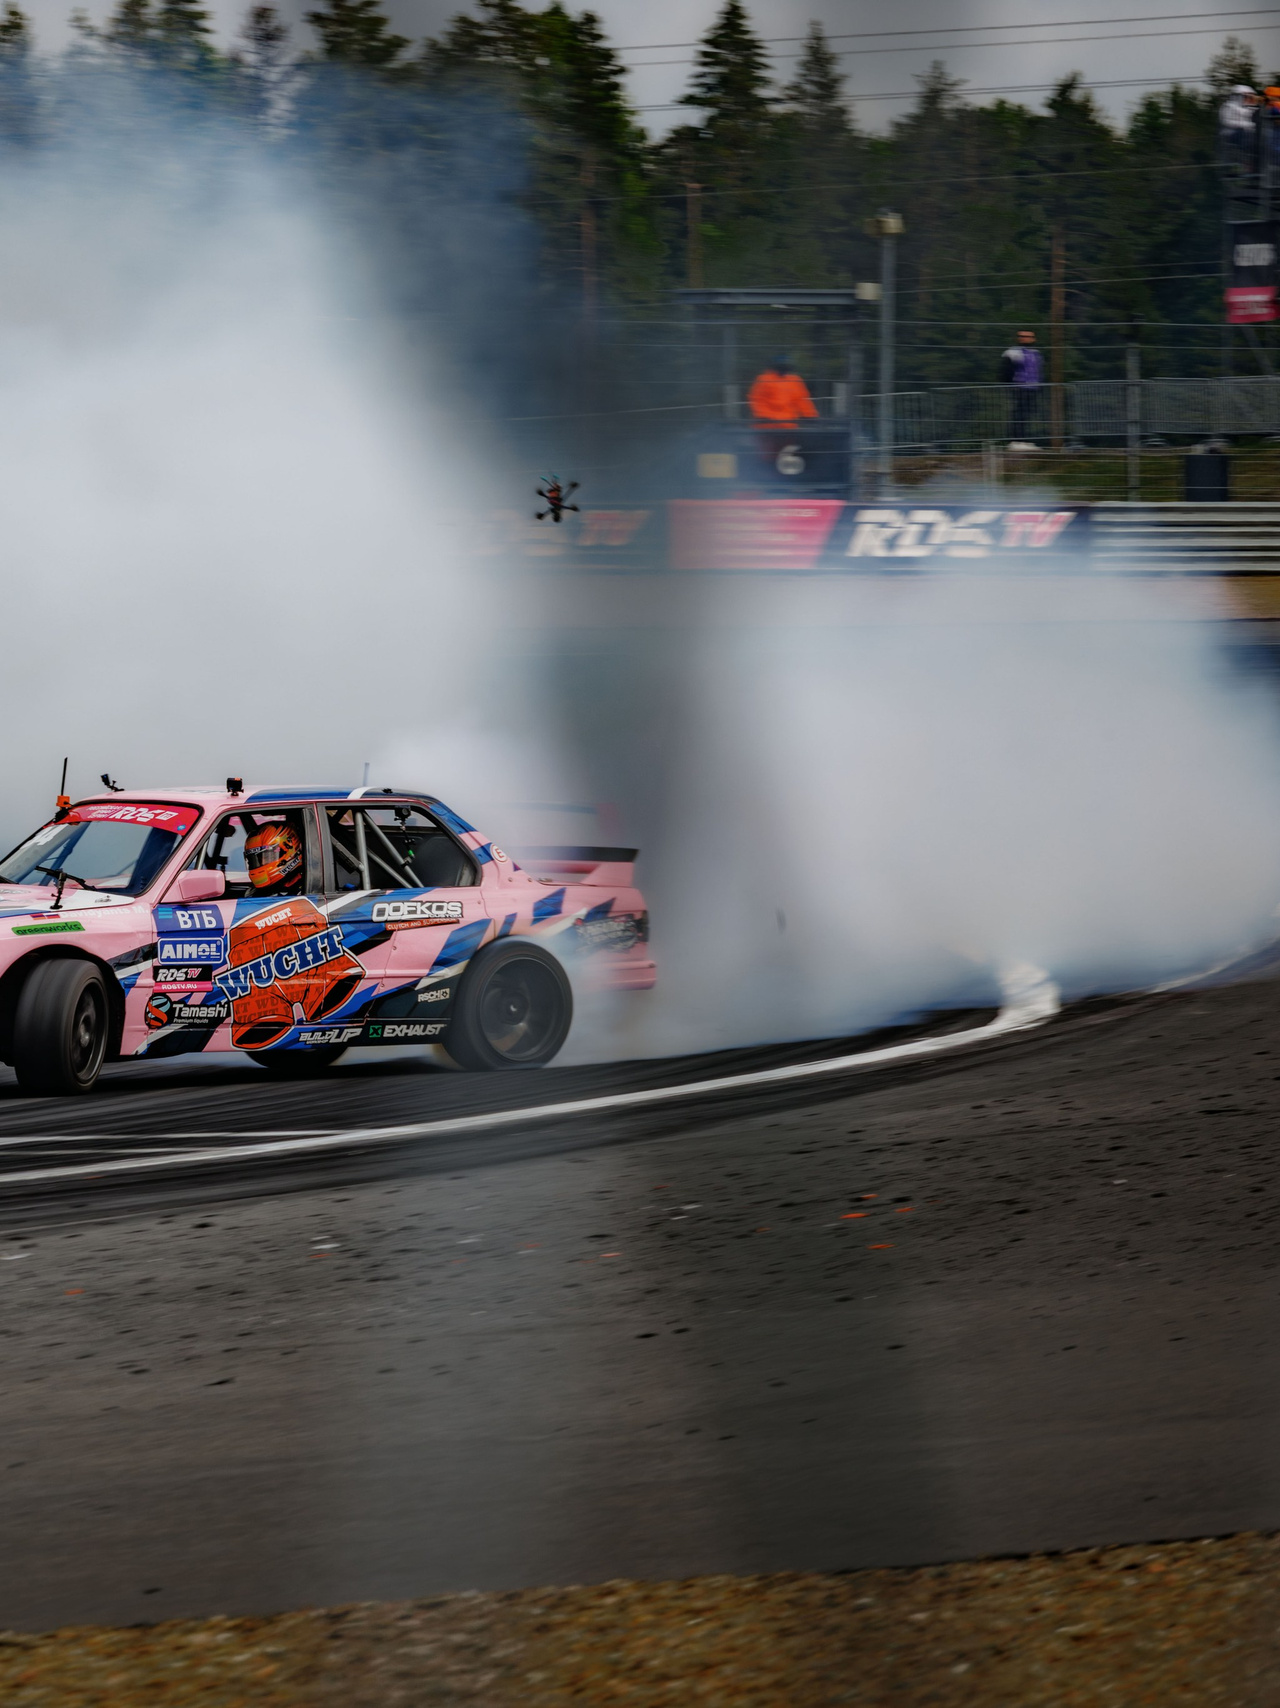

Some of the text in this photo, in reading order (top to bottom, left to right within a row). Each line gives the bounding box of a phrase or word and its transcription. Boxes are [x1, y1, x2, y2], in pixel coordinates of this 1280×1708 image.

[776, 444, 806, 475] 6
[109, 806, 165, 823] RDS
[176, 910, 217, 929] ВТБ
[255, 907, 293, 930] WUCHT
[16, 922, 81, 936] greenworks
[161, 943, 220, 959] AIMOL
[215, 925, 344, 1001] WUCHT
[172, 1003, 228, 1018] Tamashi
[383, 1024, 445, 1038] EXHAUST
